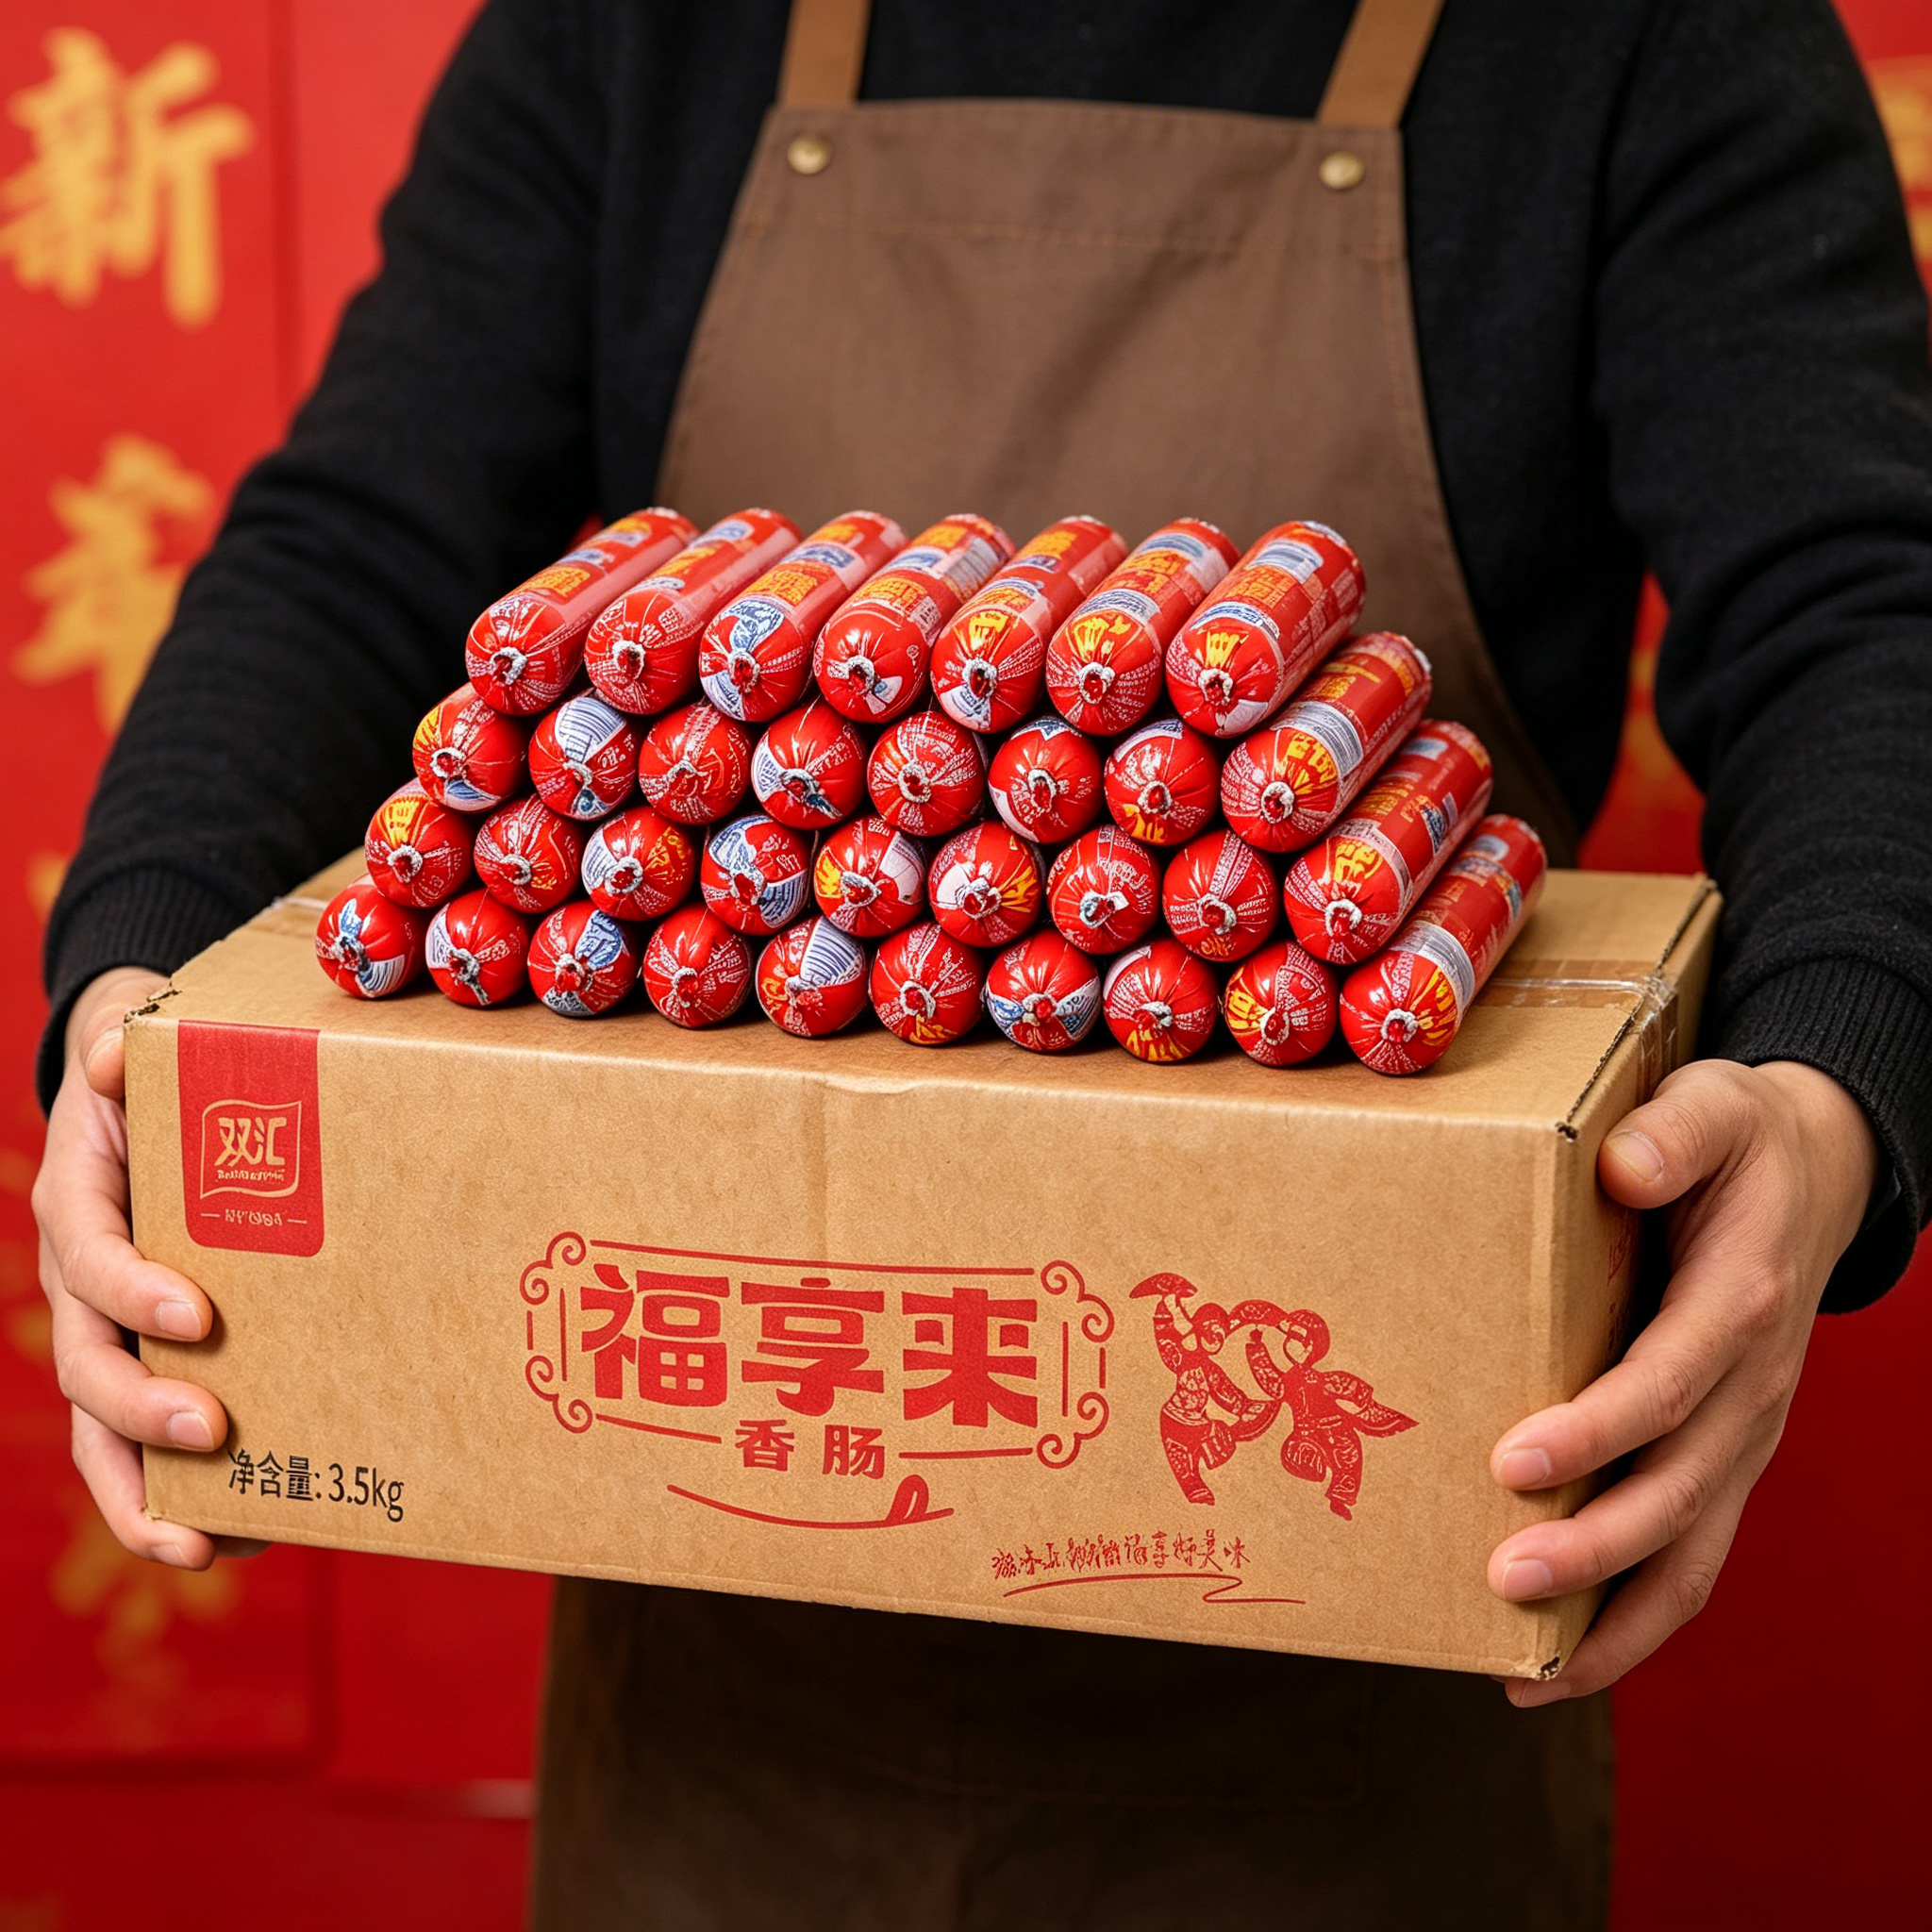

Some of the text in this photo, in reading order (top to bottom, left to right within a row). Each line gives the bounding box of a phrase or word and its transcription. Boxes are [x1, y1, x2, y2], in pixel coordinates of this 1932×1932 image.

[0, 26, 256, 328] 新
[213, 1116, 288, 1167] 双汇
[580, 1263, 1039, 1428] 福享来
[734, 1419, 887, 1480] 香肠
